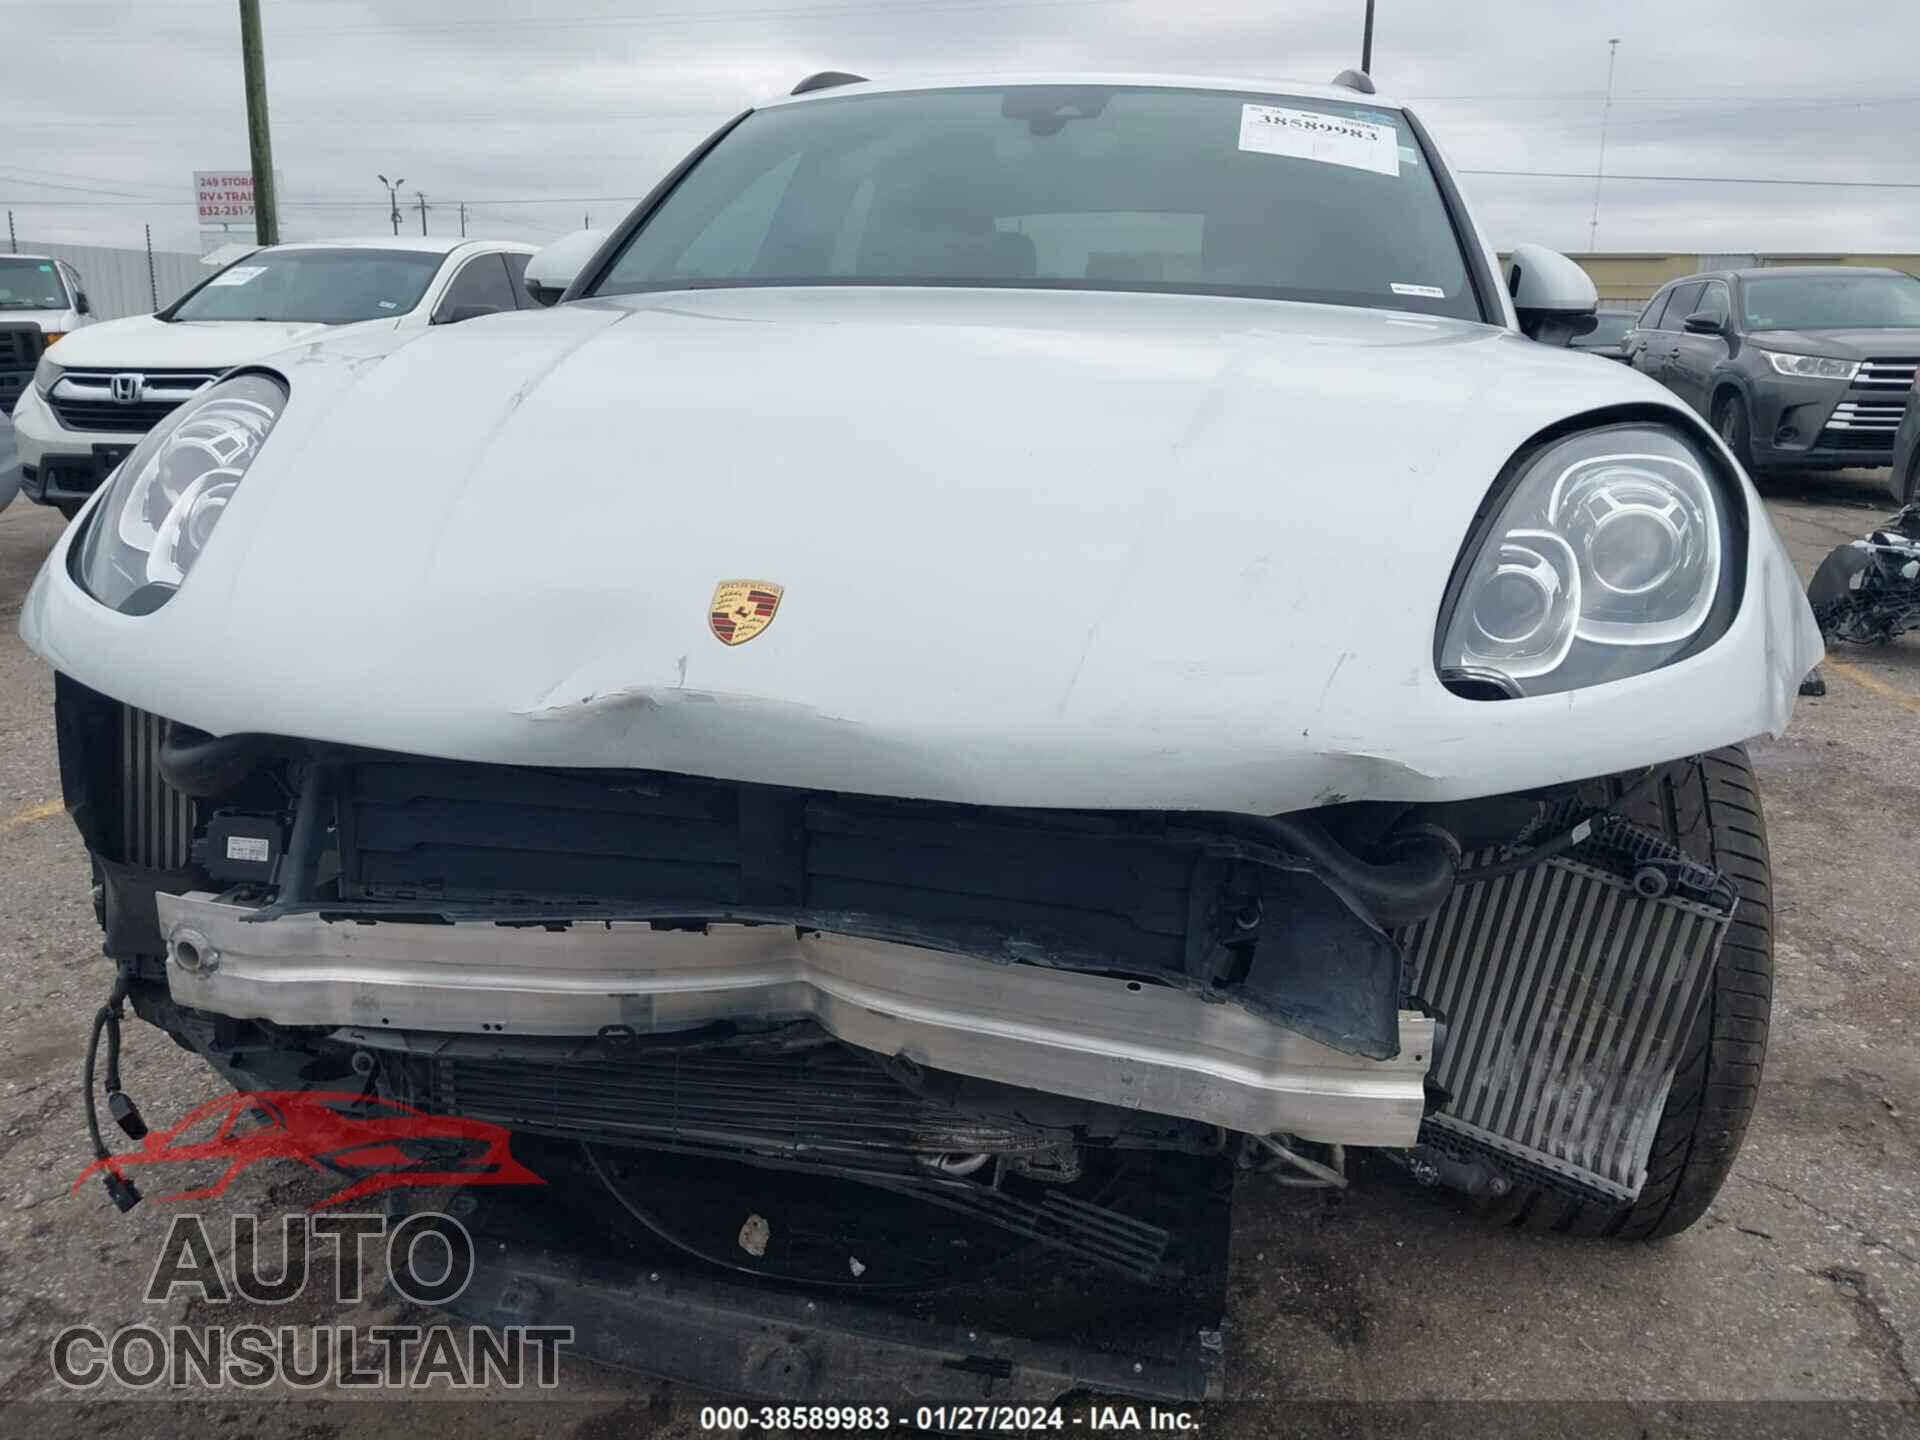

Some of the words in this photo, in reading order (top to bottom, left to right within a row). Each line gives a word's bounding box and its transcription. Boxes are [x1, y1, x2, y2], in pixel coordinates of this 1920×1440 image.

[1258, 114, 1379, 142] 38589983
[200, 177, 219, 187] 249
[221, 177, 256, 187] STORA
[200, 191, 216, 201] RV
[224, 191, 256, 201] TRAI
[200, 206, 256, 216] 832-251-7
